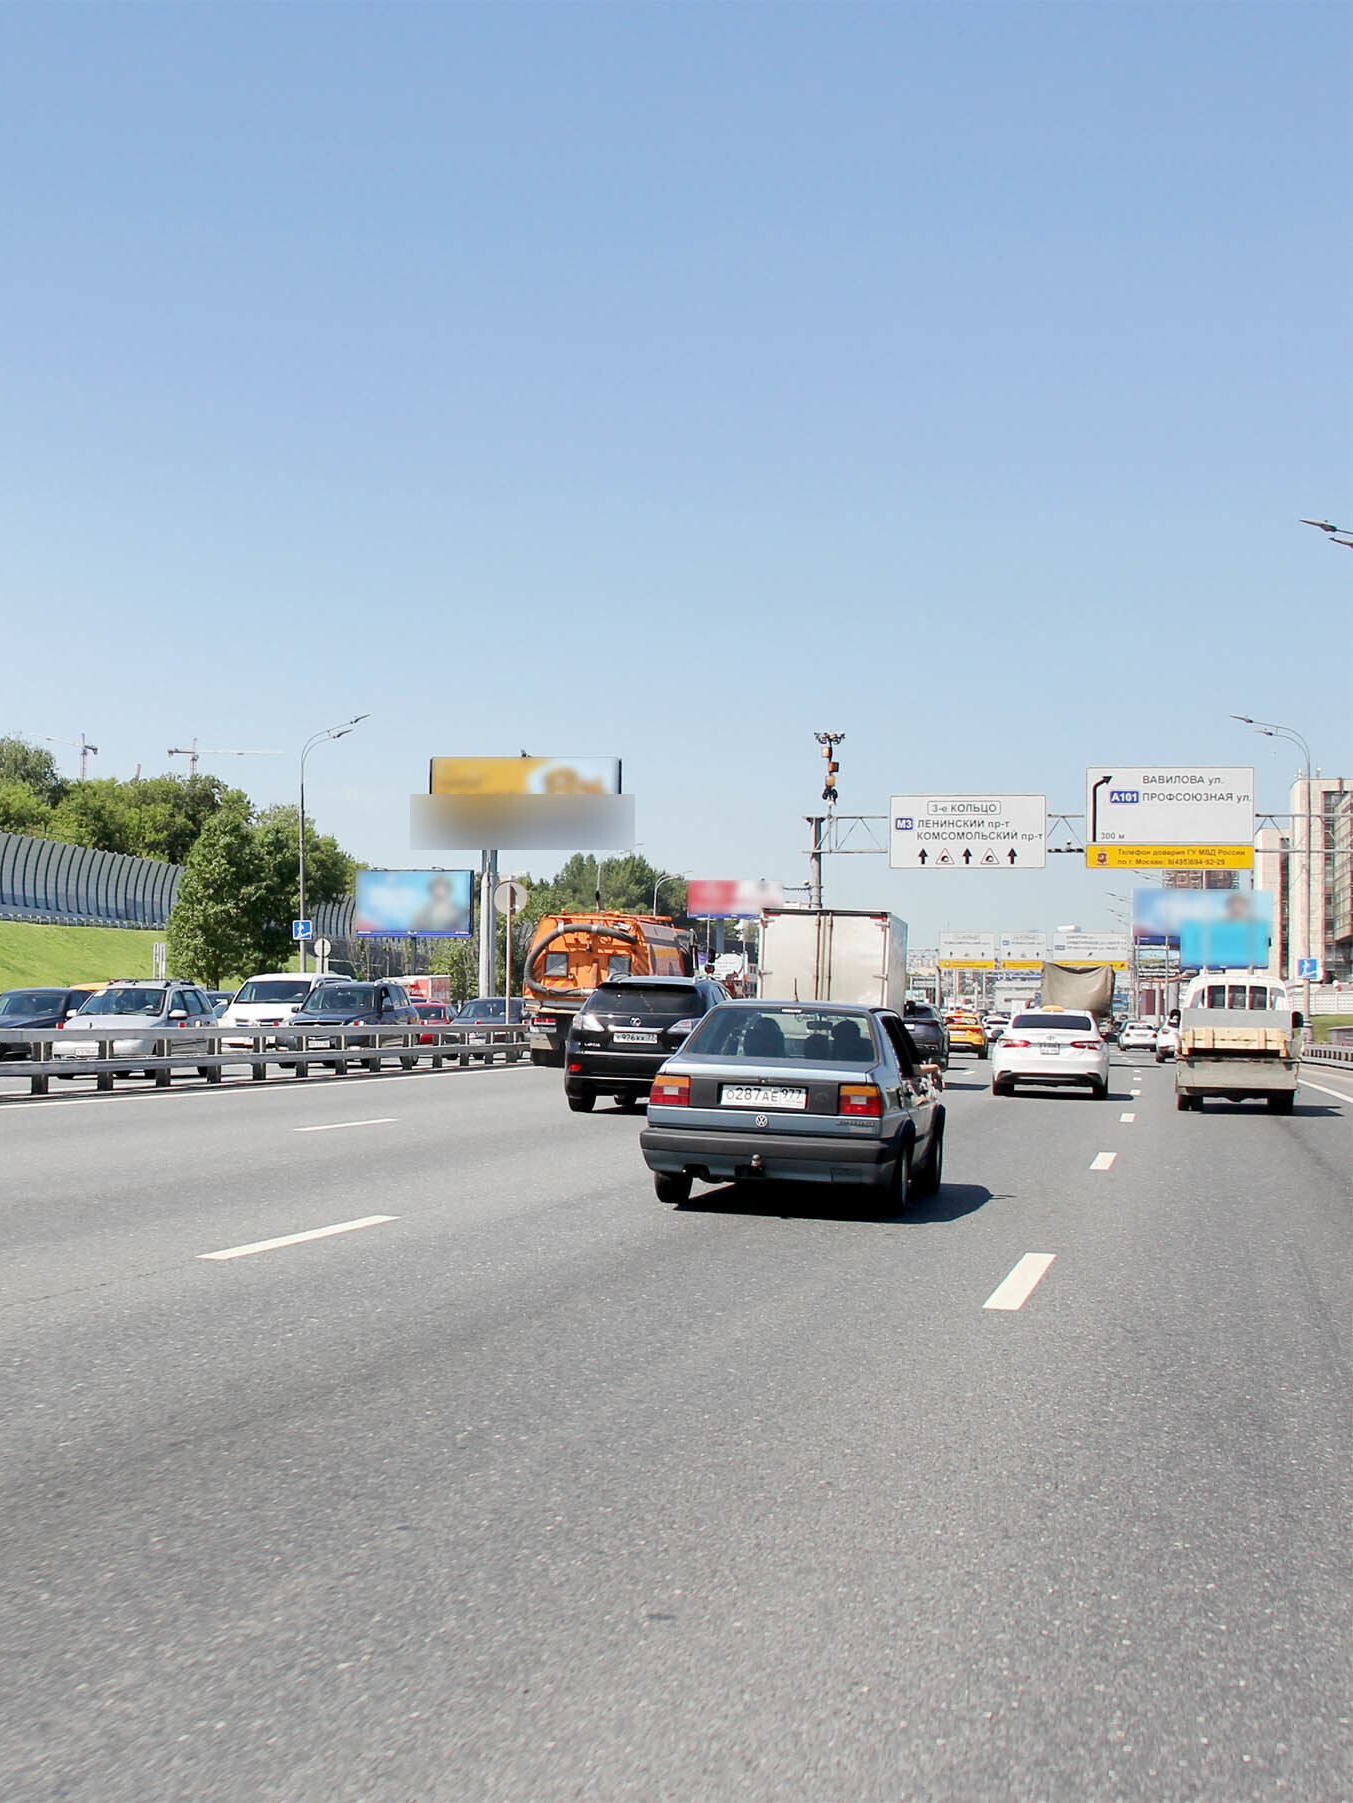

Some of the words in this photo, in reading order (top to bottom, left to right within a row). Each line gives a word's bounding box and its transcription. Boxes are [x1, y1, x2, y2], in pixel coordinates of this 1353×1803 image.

[1142, 775, 1205, 785] ВАВИЛОВА
[1208, 776, 1224, 786] ул.
[1110, 792, 1138, 802] А101
[1142, 792, 1233, 802] ПРОФСОЮЗНАЯ
[1236, 794, 1252, 804] ул.
[932, 804, 948, 813] 3-е
[950, 803, 997, 814] КОЛЬЦО
[896, 819, 912, 829] М3
[917, 817, 985, 828] ЛЕНИНСКИЙ
[988, 821, 1010, 830] пр-т
[916, 830, 1018, 841] КОМСОМОЛЬСКИЙ
[1021, 833, 1043, 842] пр-т
[1100, 832, 1116, 840] 300
[1118, 848, 1151, 857] Телефон
